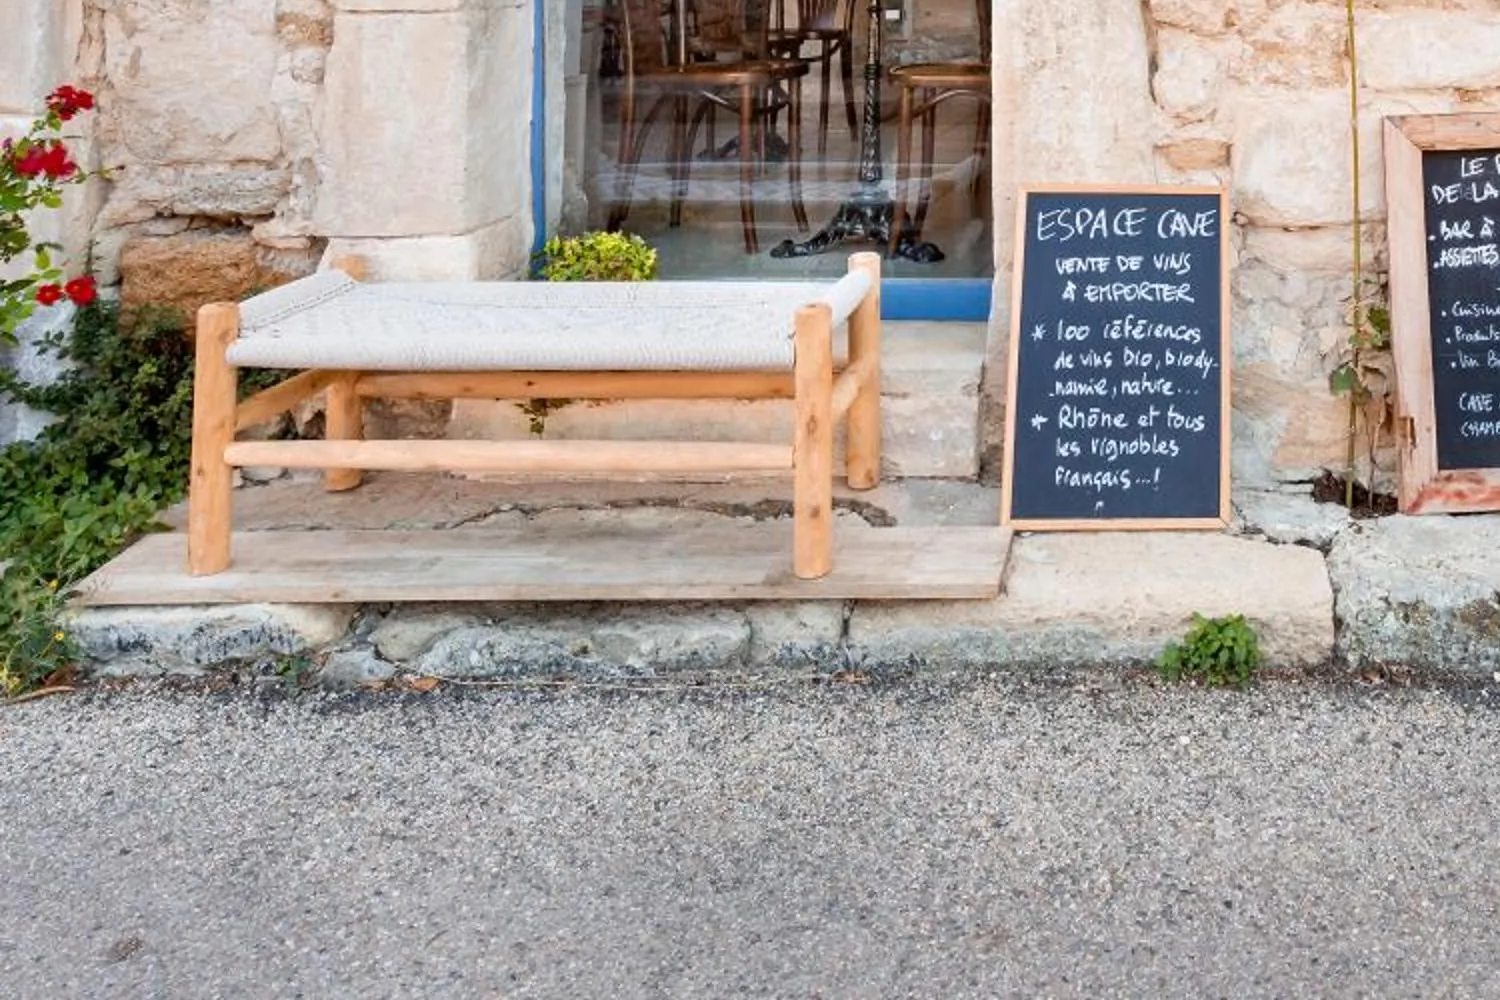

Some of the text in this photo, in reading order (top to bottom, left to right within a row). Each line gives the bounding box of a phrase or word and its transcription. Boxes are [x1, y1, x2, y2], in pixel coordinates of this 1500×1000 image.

[1460, 156, 1489, 178] LE
[1431, 183, 1462, 205] DE
[1471, 181, 1500, 203] LA
[1037, 206, 1217, 243] ESPACE CAVE
[1440, 220, 1475, 241] BAR
[1479, 217, 1496, 239] À
[1055, 252, 1192, 275] VENTE DE VINS
[1438, 243, 1500, 269] ASSIETTES
[1083, 281, 1195, 304] EMPORTER
[1056, 319, 1091, 342] 100
[1053, 350, 1075, 371] de
[1458, 392, 1494, 412] CAVE
[1058, 402, 1206, 432] Rhône et tous
[1055, 437, 1082, 458] les
